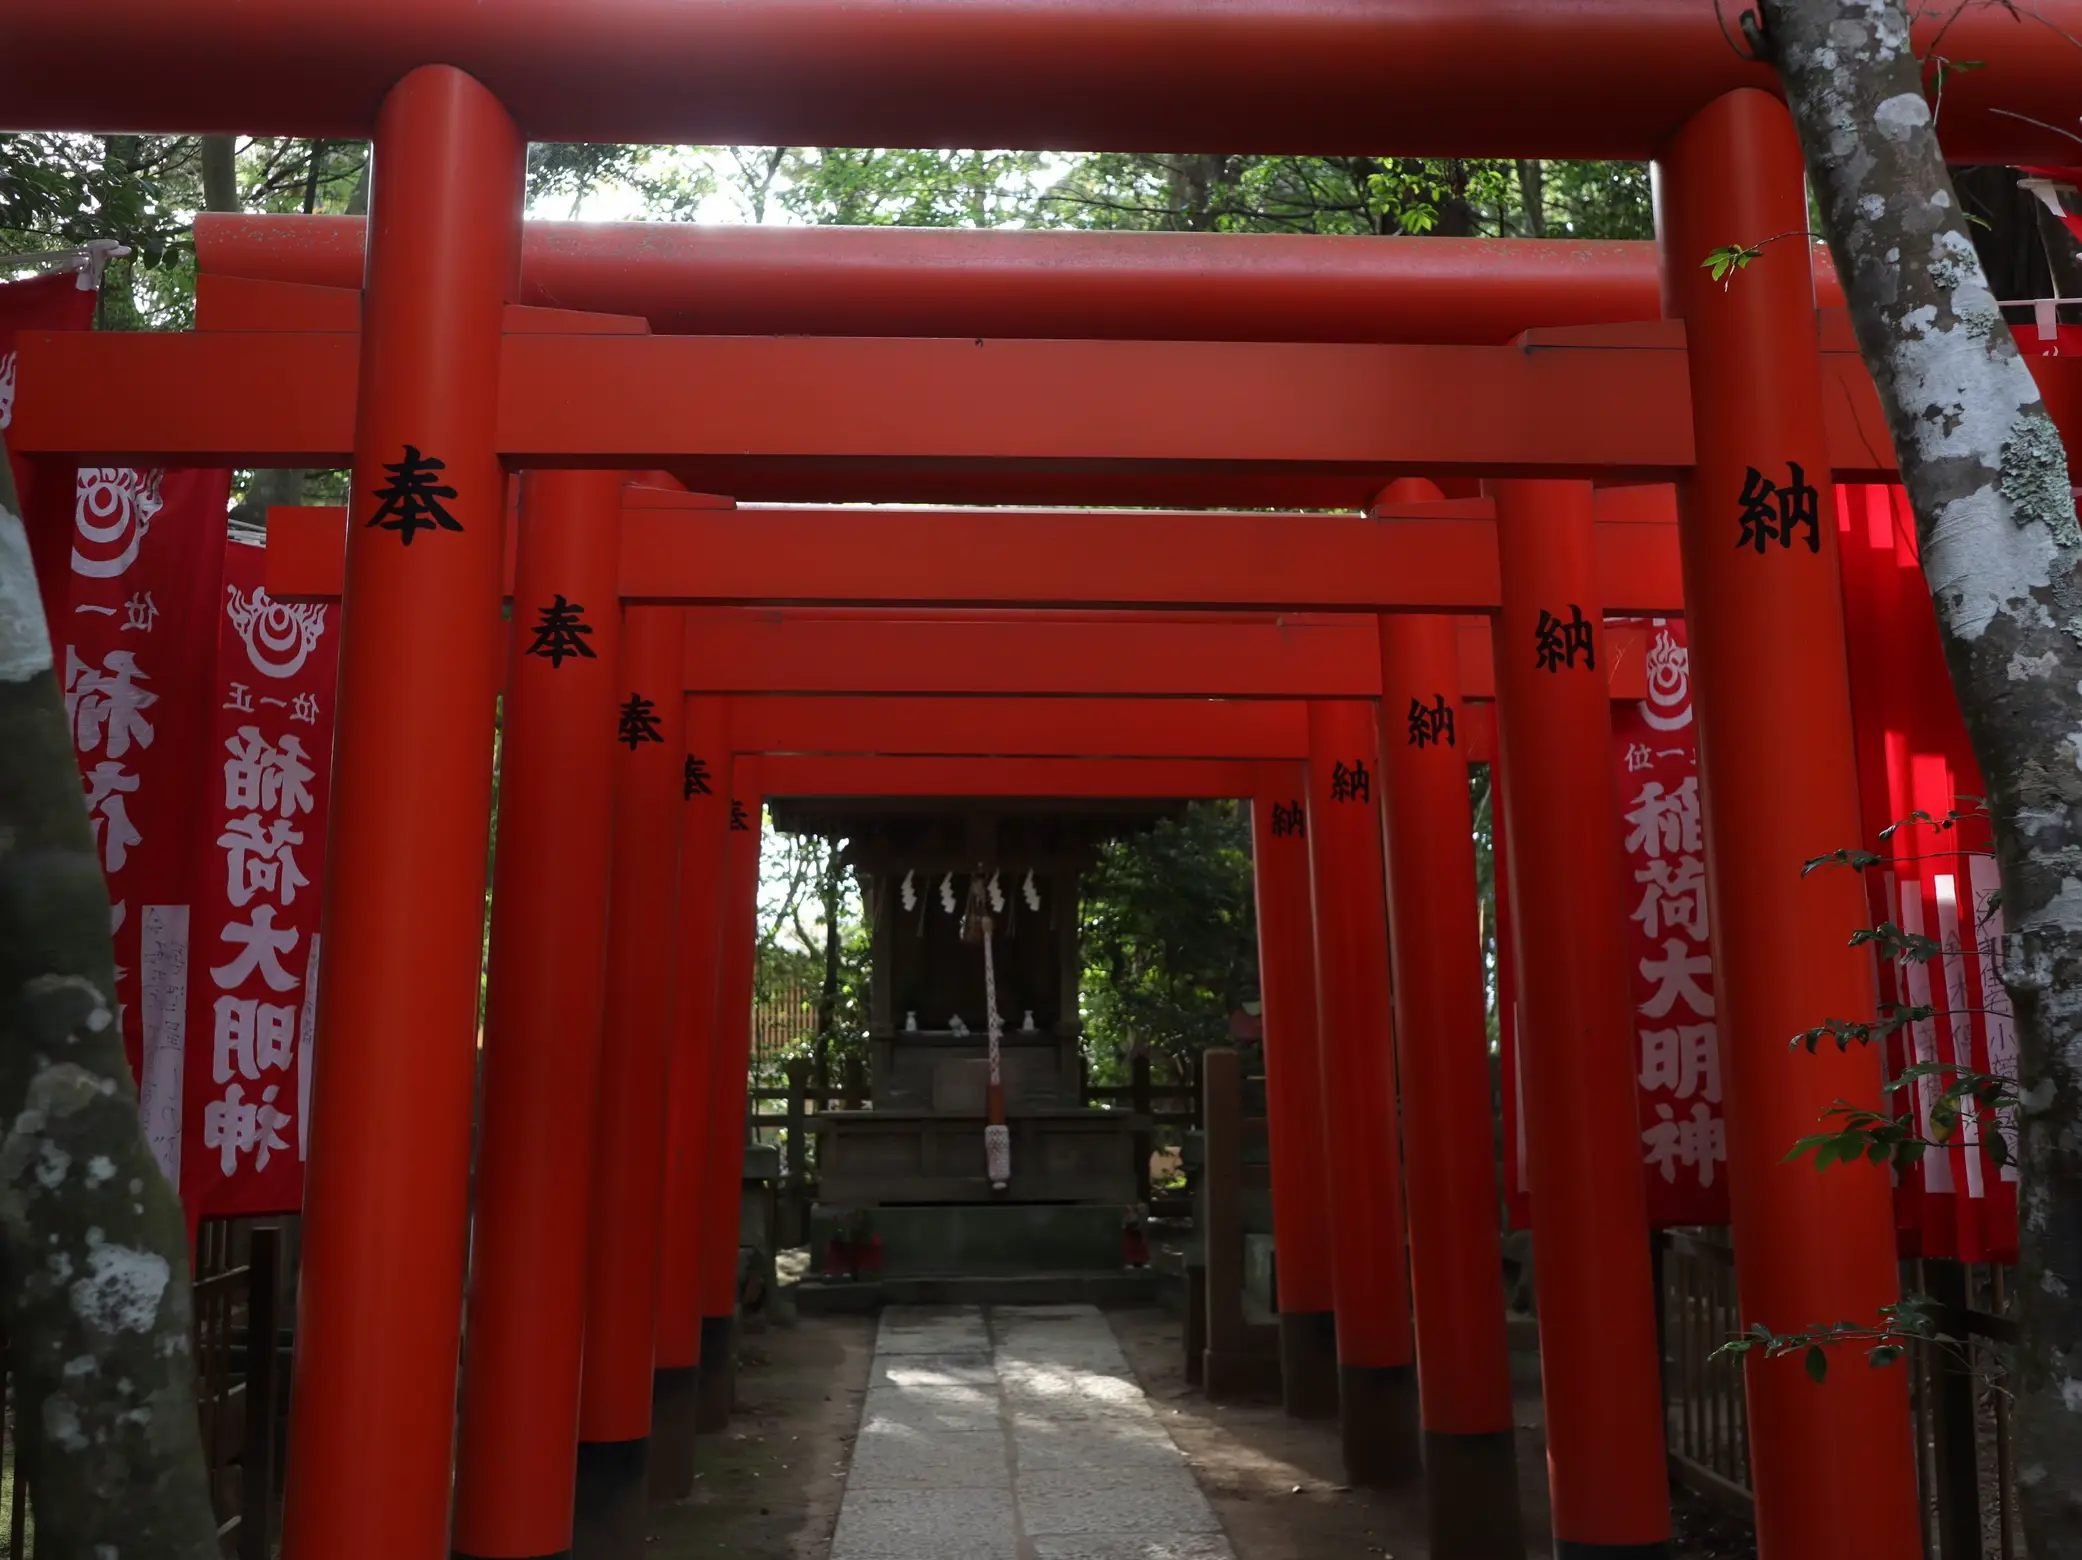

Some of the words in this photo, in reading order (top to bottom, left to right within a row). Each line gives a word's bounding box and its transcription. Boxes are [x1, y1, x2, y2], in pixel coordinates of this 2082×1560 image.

[366, 445, 464, 546] 奉
[1739, 461, 1819, 554] 納
[525, 595, 597, 668] 奉
[1535, 605, 1595, 673] 納
[618, 693, 664, 751] 奉
[1408, 695, 1455, 748] 納
[1332, 760, 1369, 804] 納
[1272, 800, 1306, 838] 納
[1625, 777, 1727, 1188] 稲荷大明神
